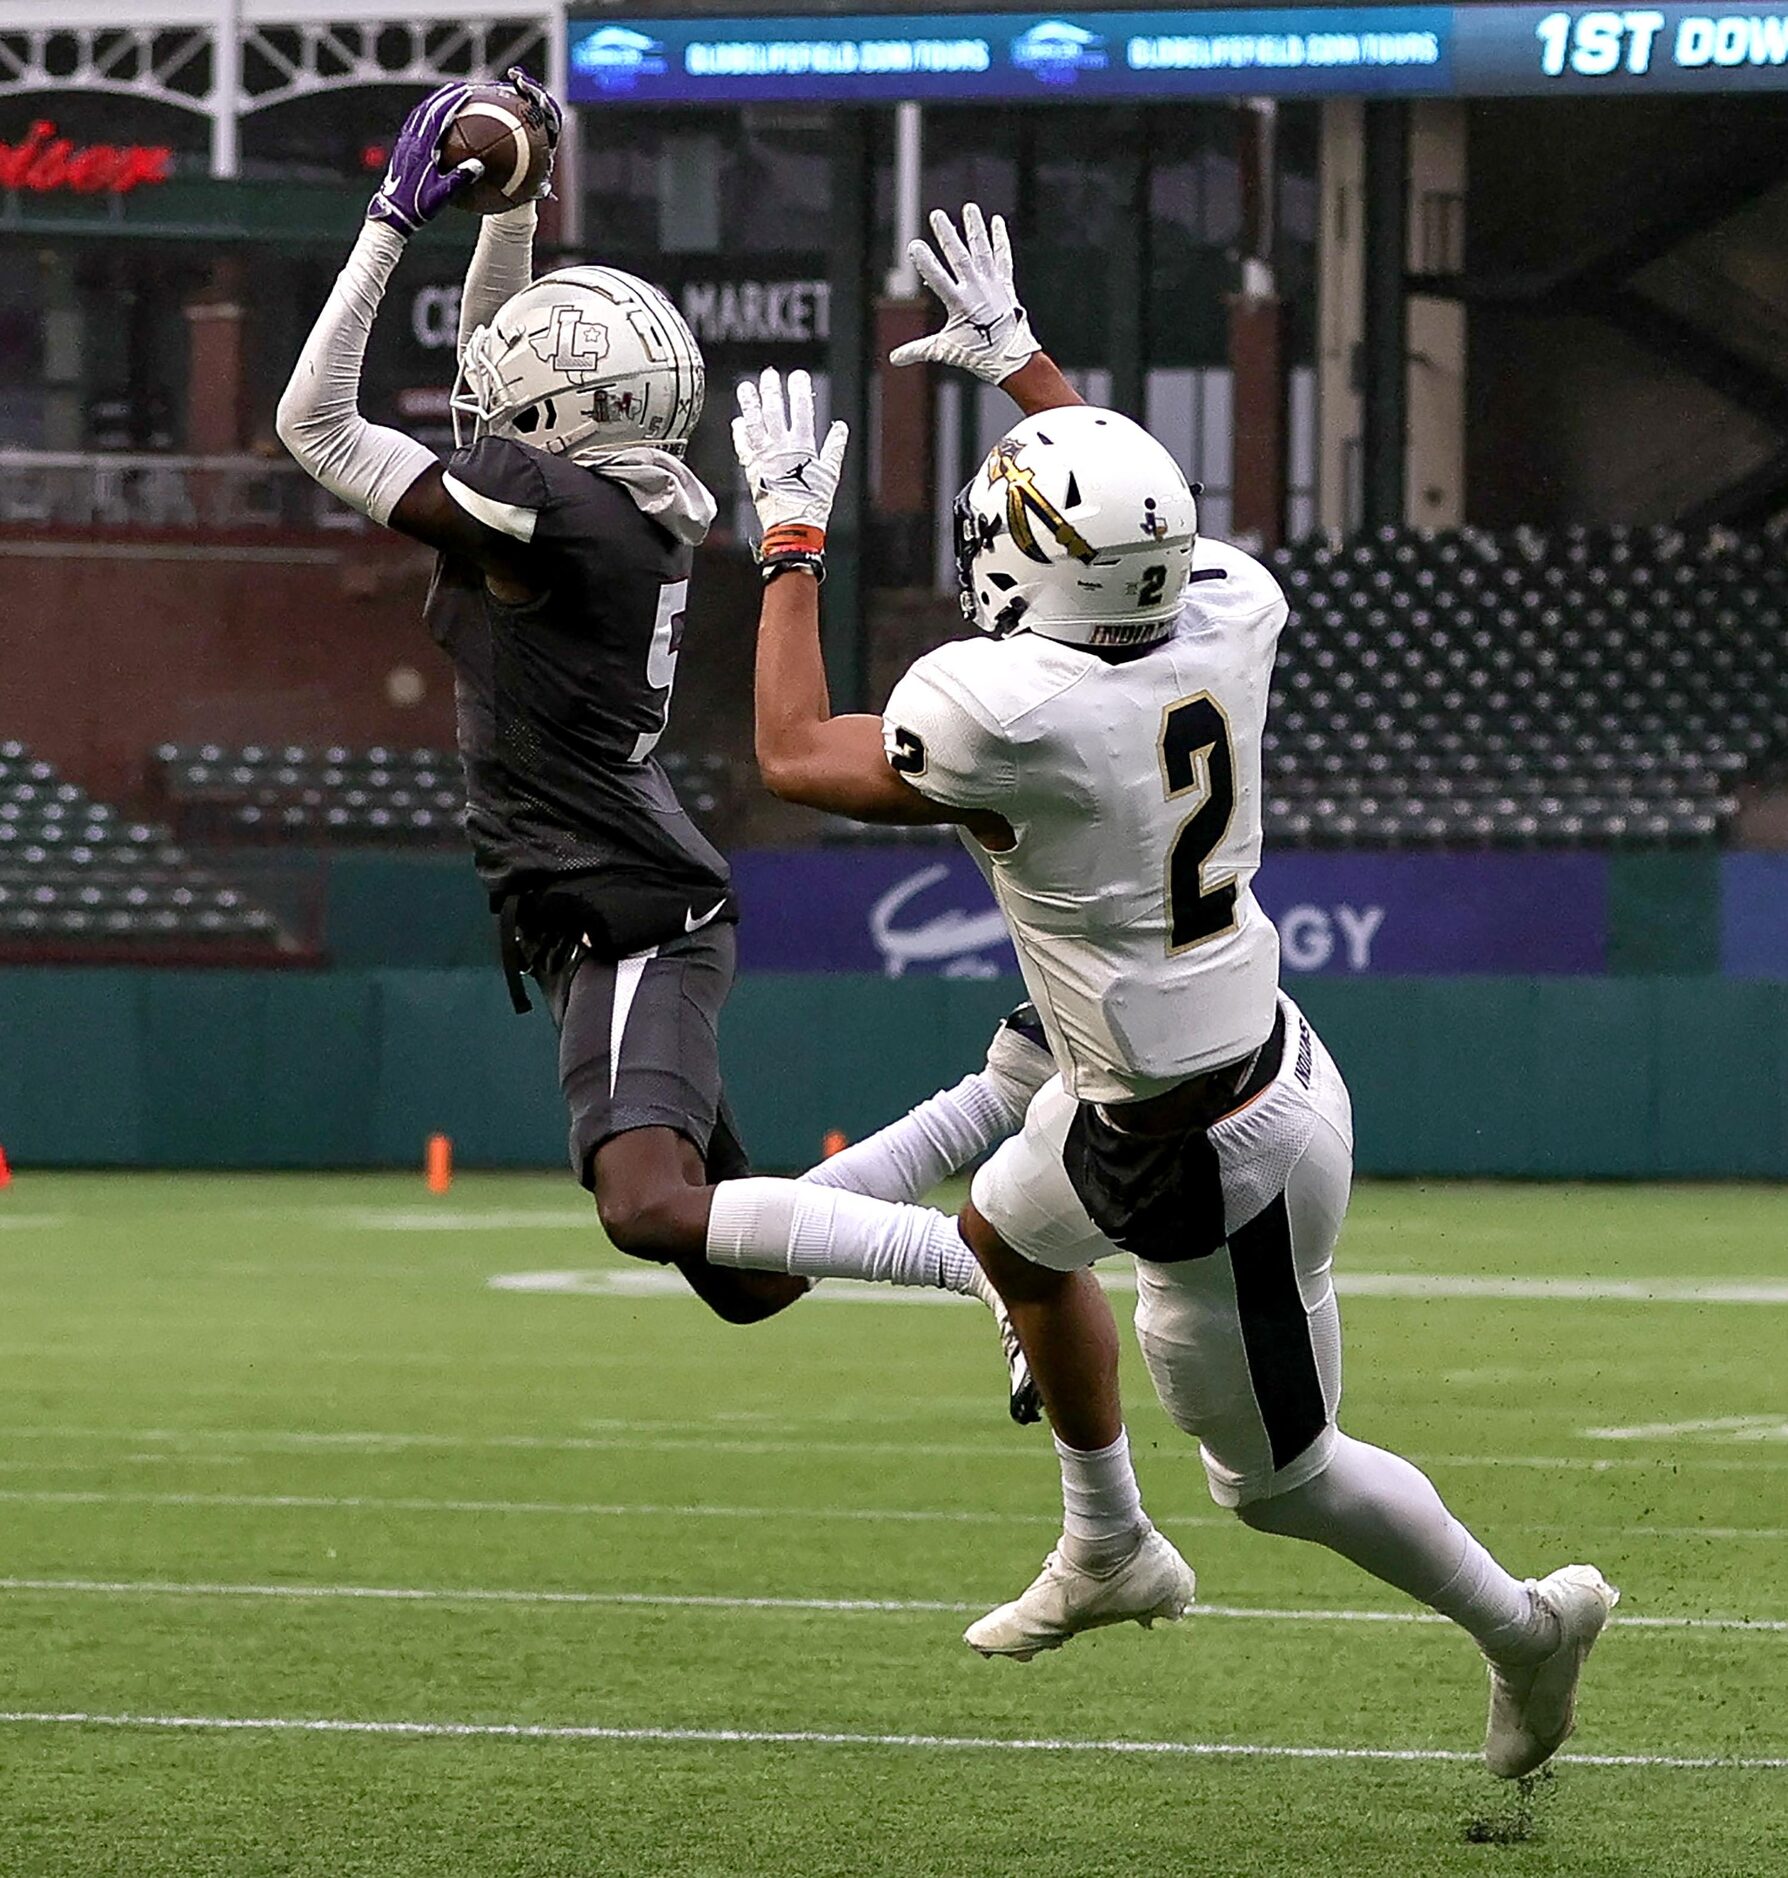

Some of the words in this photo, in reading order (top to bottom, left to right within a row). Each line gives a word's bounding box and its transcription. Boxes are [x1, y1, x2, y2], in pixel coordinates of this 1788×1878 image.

[1535, 10, 1666, 76] 1ST
[683, 280, 831, 343] MARKET
[1137, 564, 1167, 608] 2
[1156, 688, 1239, 958] 2
[1282, 906, 1386, 971] GY
